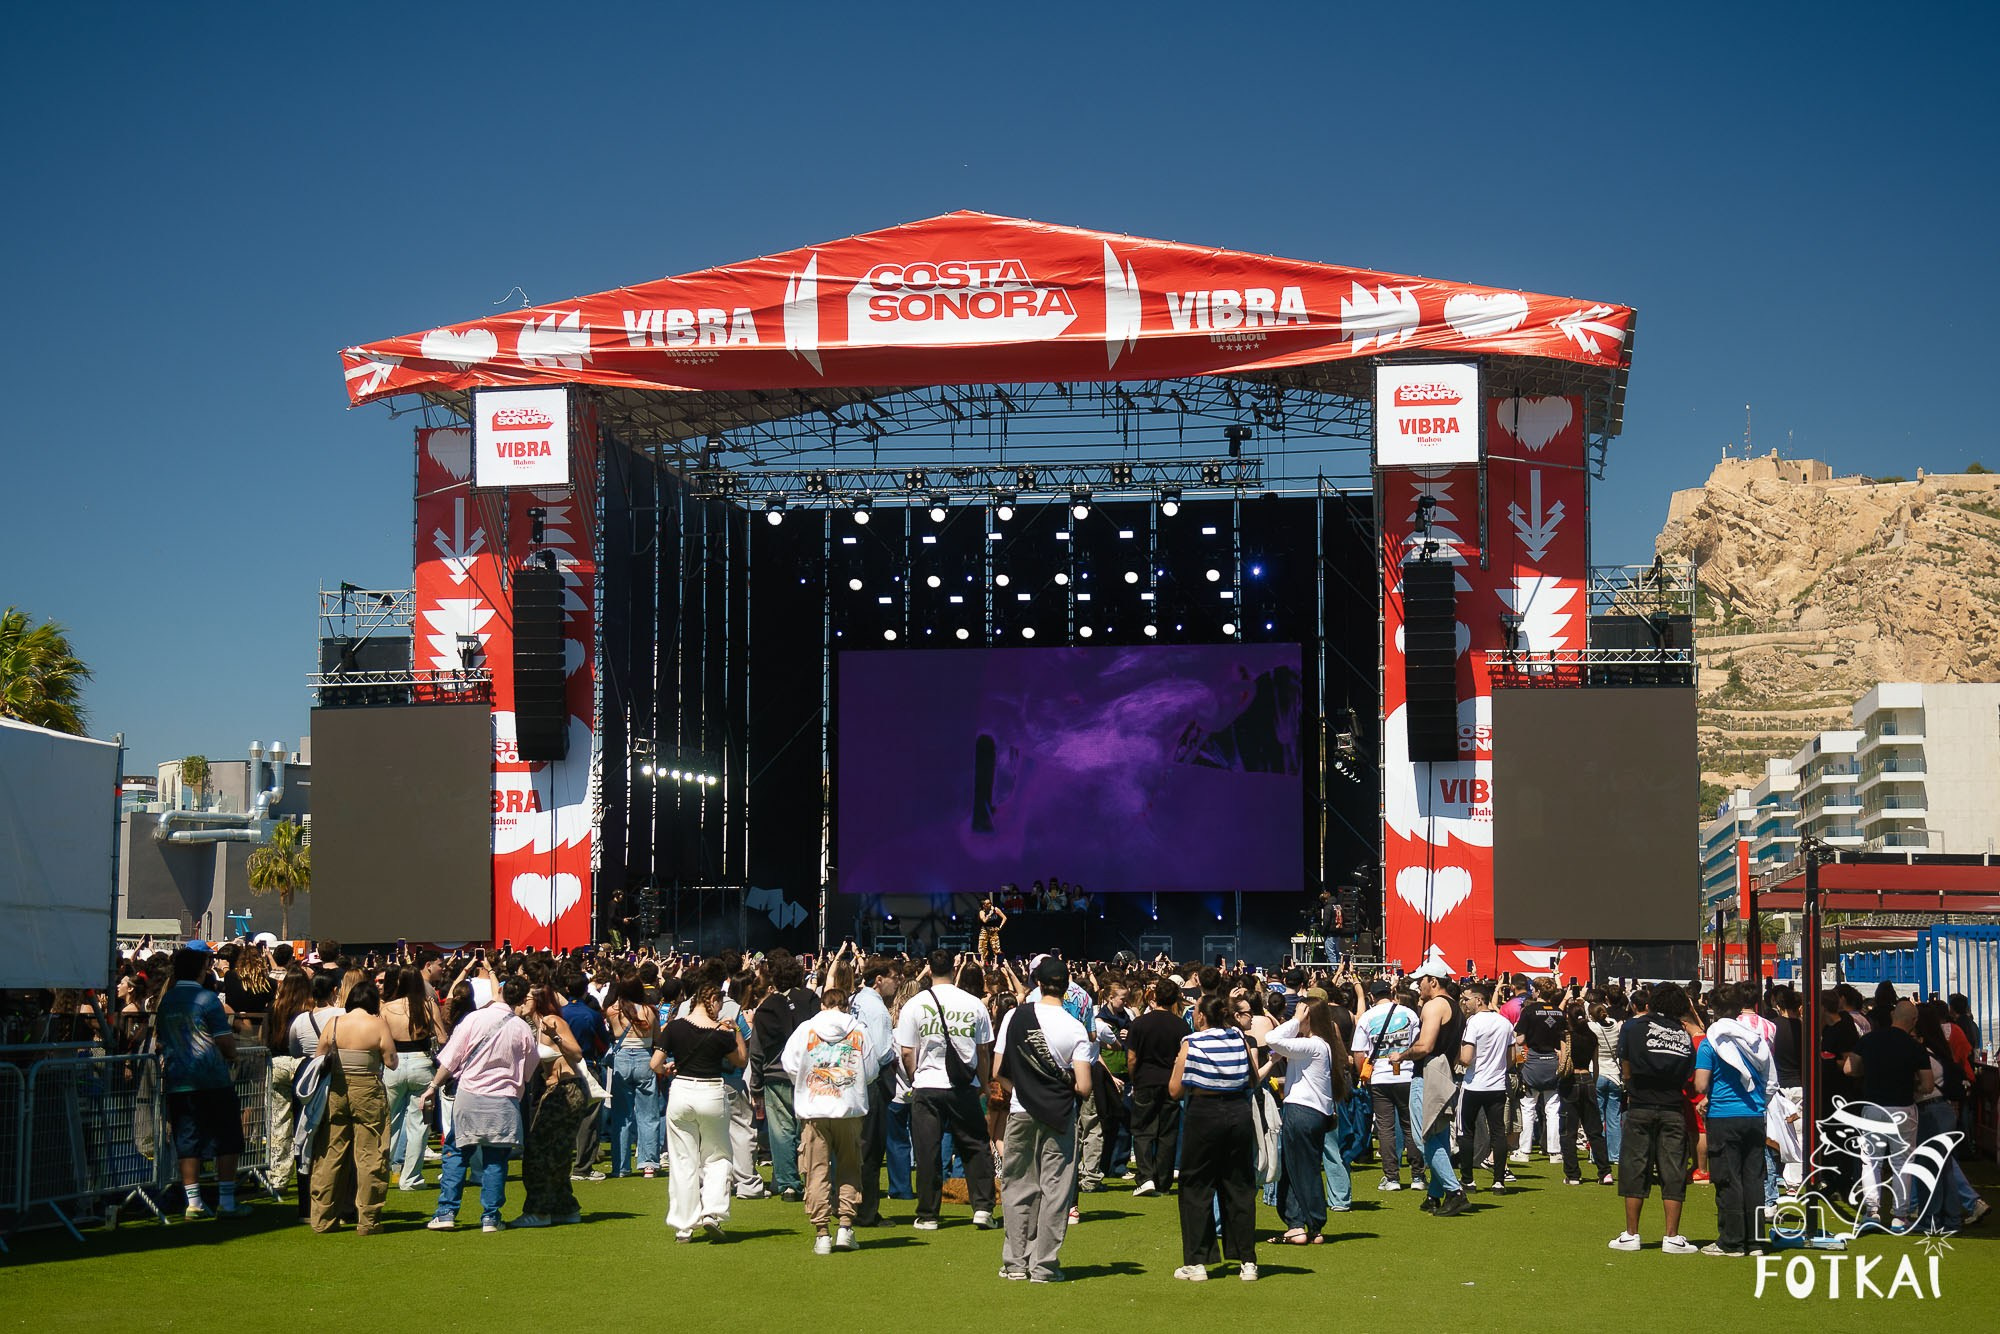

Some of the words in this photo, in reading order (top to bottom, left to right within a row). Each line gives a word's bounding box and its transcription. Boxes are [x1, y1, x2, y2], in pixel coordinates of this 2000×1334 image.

[868, 260, 1032, 292] COSTA
[868, 289, 1075, 322] SONORA
[1165, 286, 1310, 332] VIBRA
[622, 307, 760, 347] VIBRA
[1399, 382, 1450, 391] COSTA
[1399, 390, 1463, 401] SONORA
[497, 407, 542, 416] COSTA
[497, 414, 555, 426] SONORA
[1398, 417, 1460, 435] VIBRA
[496, 440, 552, 458] VIBRA
[1440, 779, 1493, 804] VIB
[491, 790, 542, 813] BRA
[1468, 807, 1493, 816] Mah
[491, 817, 518, 825] ahou
